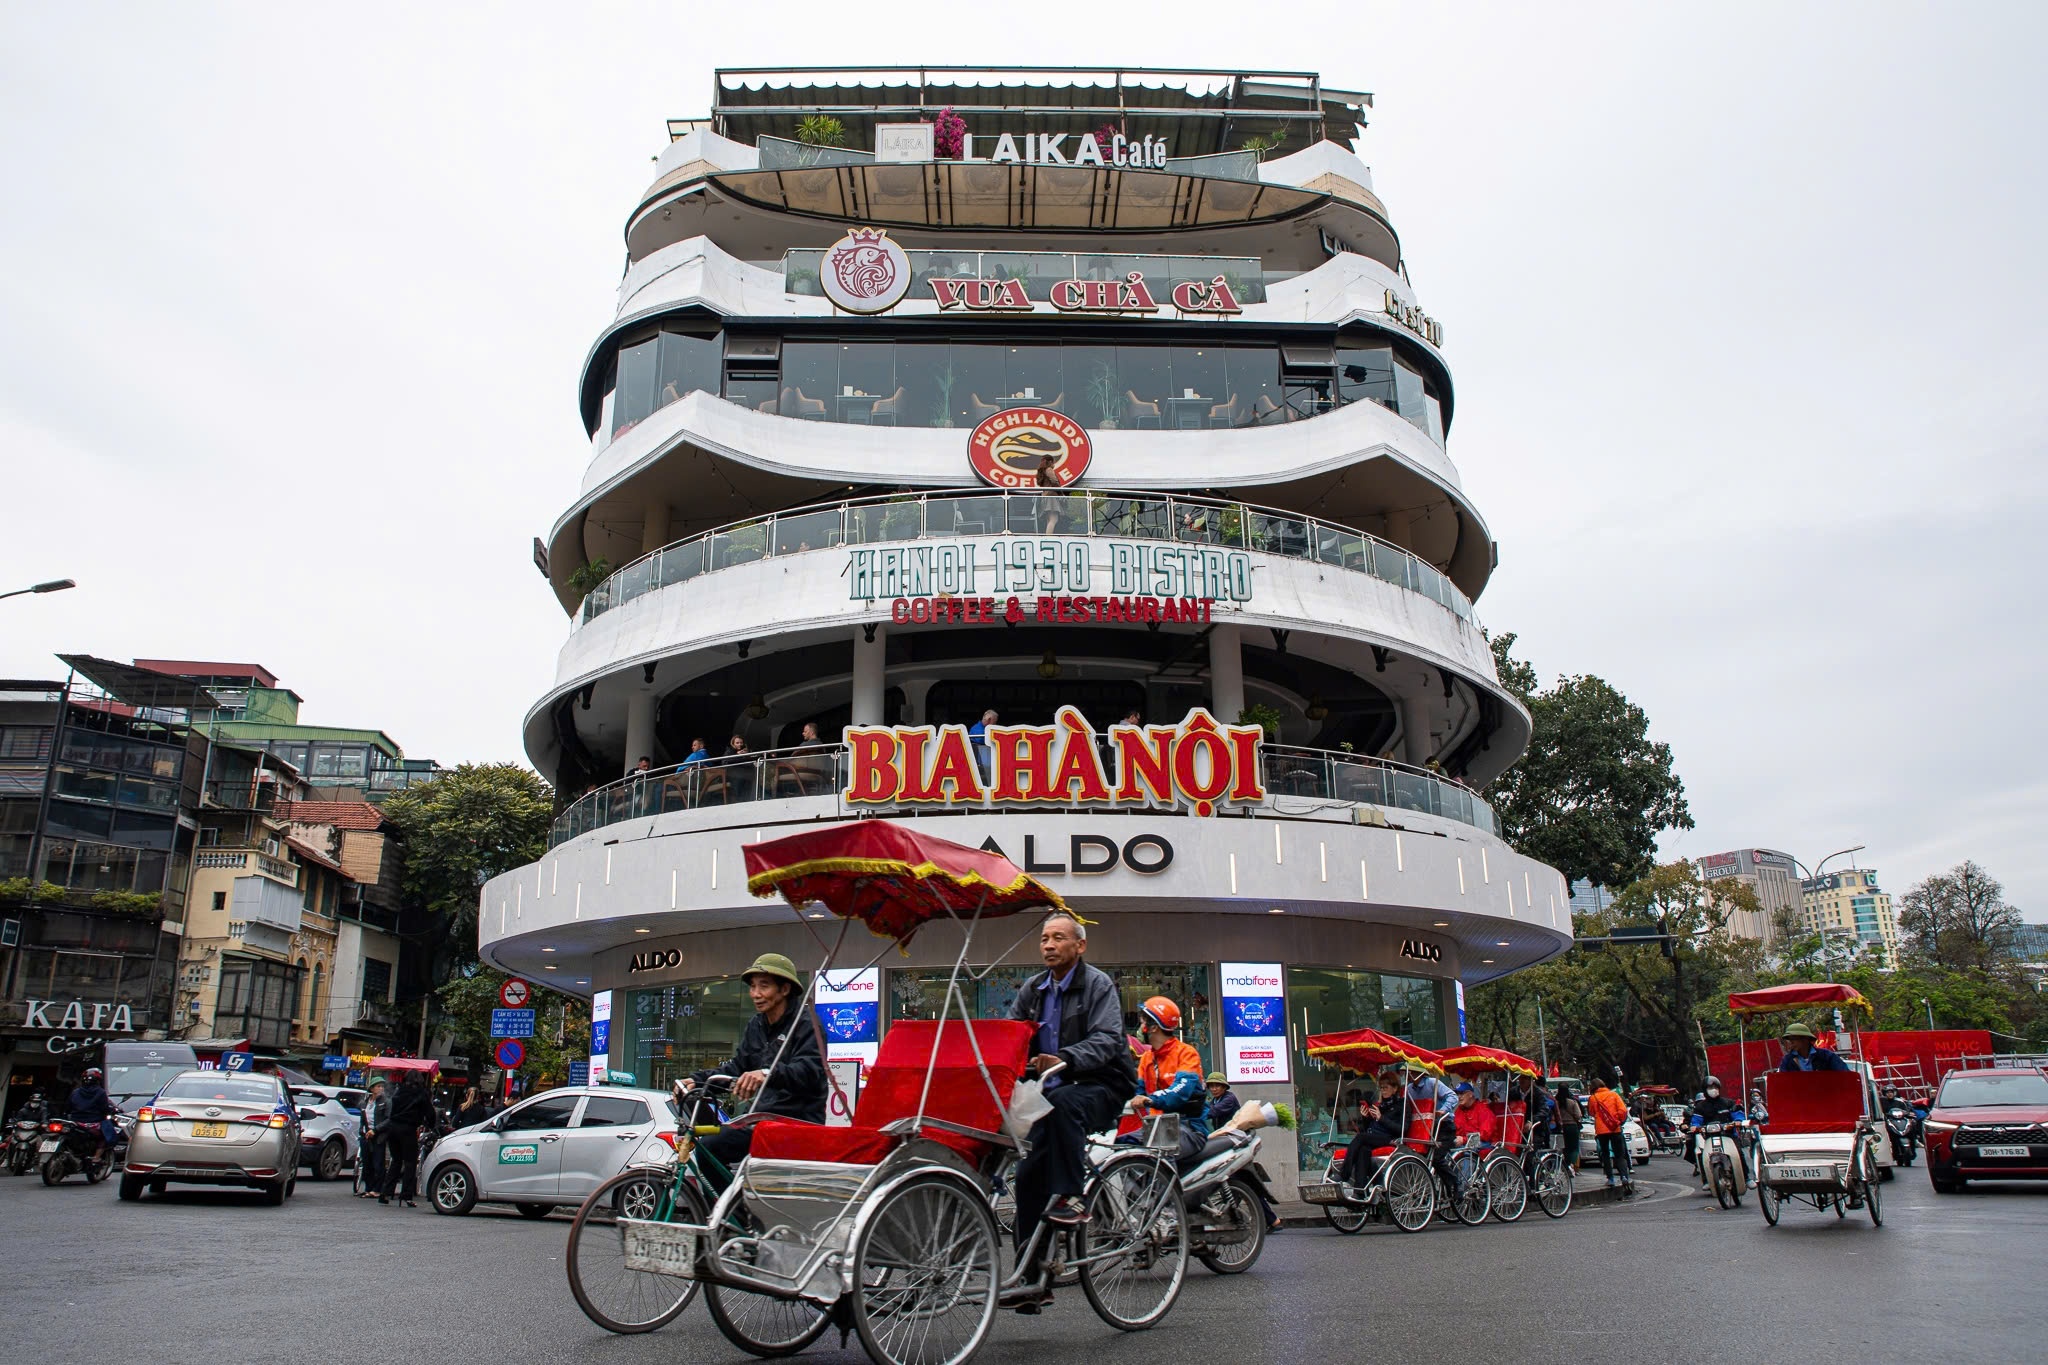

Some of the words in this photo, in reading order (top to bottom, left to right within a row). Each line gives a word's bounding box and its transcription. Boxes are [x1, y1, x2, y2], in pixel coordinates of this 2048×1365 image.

[963, 133, 1104, 166] LAIKA
[1112, 133, 1169, 170] Café
[929, 278, 1034, 311] VUA
[1050, 271, 1159, 312] CHẢ
[1172, 275, 1242, 314] CÁ
[975, 412, 1084, 448] HIGHLANDS
[989, 467, 1074, 487] COFE
[850, 544, 976, 600] HANOI
[991, 540, 1090, 593] 1930
[1109, 543, 1252, 602] BISTRO
[892, 597, 995, 624] COFFEE
[1005, 596, 1026, 623] &
[1037, 596, 1215, 624] RESTAURANT
[846, 728, 984, 803] BIA
[1114, 711, 1264, 818] NỘI
[1706, 865, 1737, 878] GROUP
[628, 948, 682, 973] ALDO
[1400, 940, 1442, 963] ALDO
[1226, 975, 1279, 986] mobifone
[21, 1000, 134, 1032] KAFA
[1252, 1066, 1275, 1074] NƯỚC
